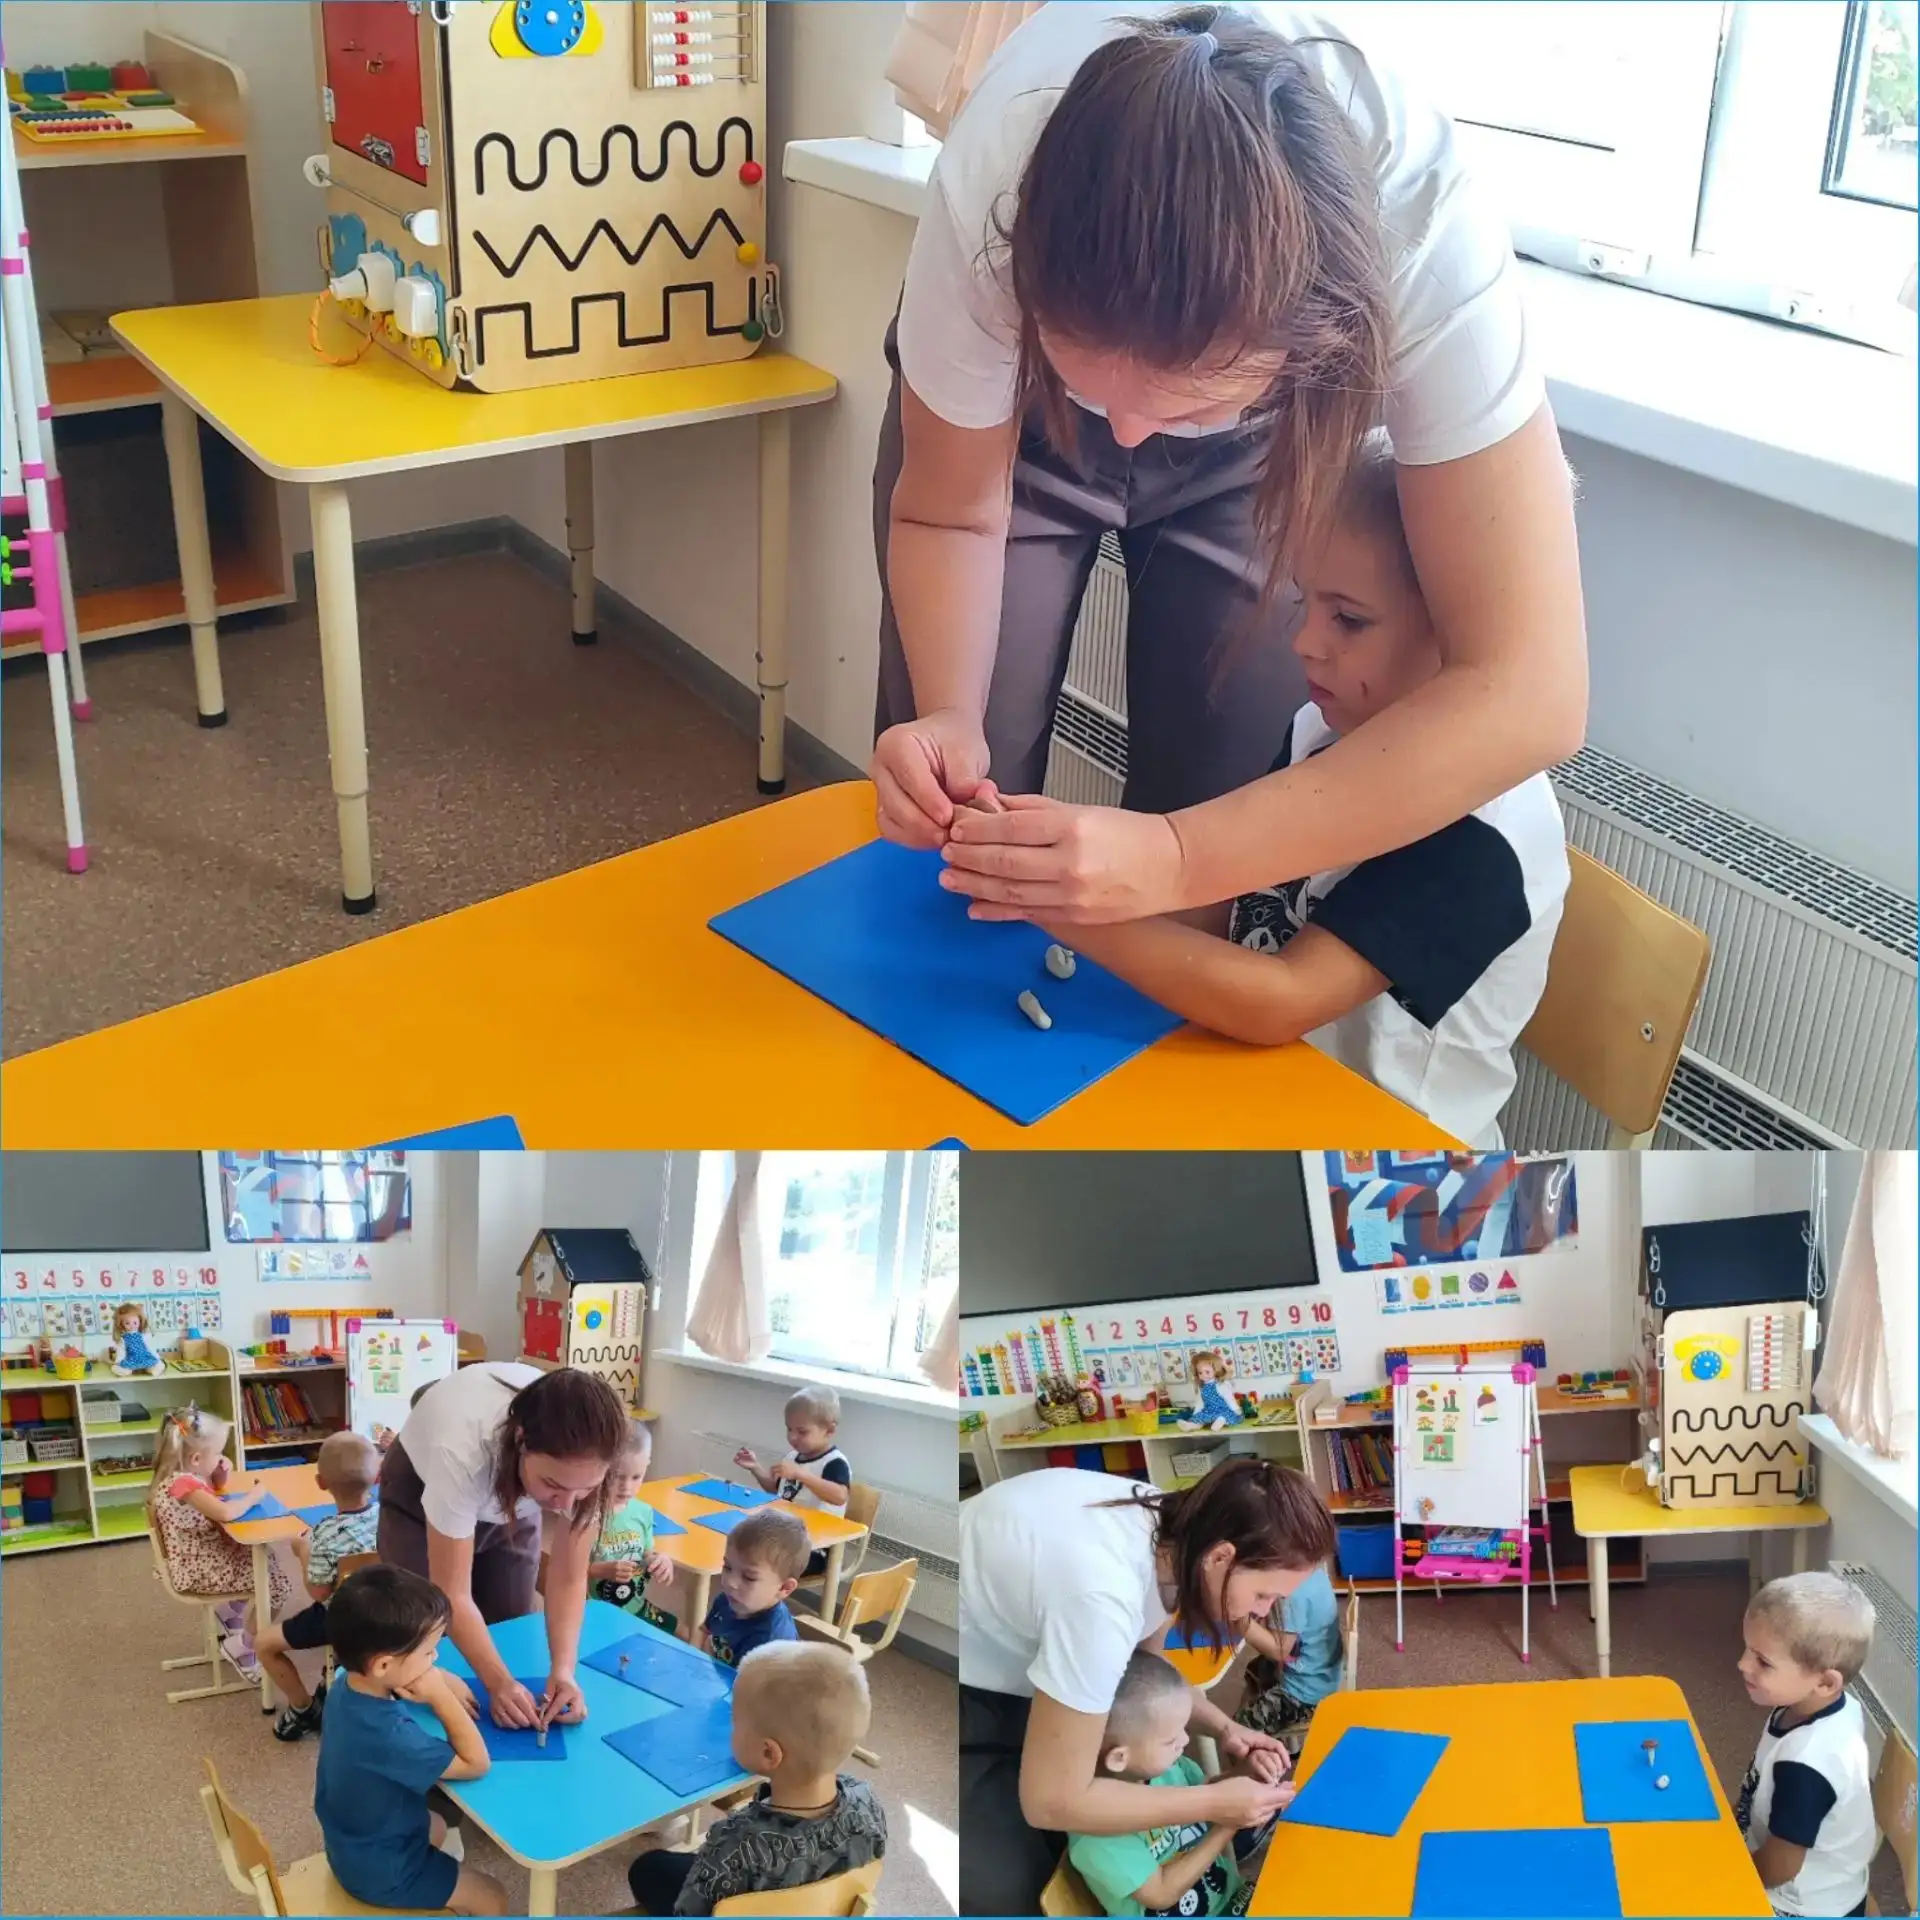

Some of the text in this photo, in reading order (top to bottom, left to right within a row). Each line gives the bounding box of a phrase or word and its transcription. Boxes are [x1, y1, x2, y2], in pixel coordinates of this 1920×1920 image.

[15, 1267, 217, 1290] 3 4 5 6 7 8 9 10
[1085, 1303, 1332, 1342] 1 2 3 4 5 6 7 8 9 10
